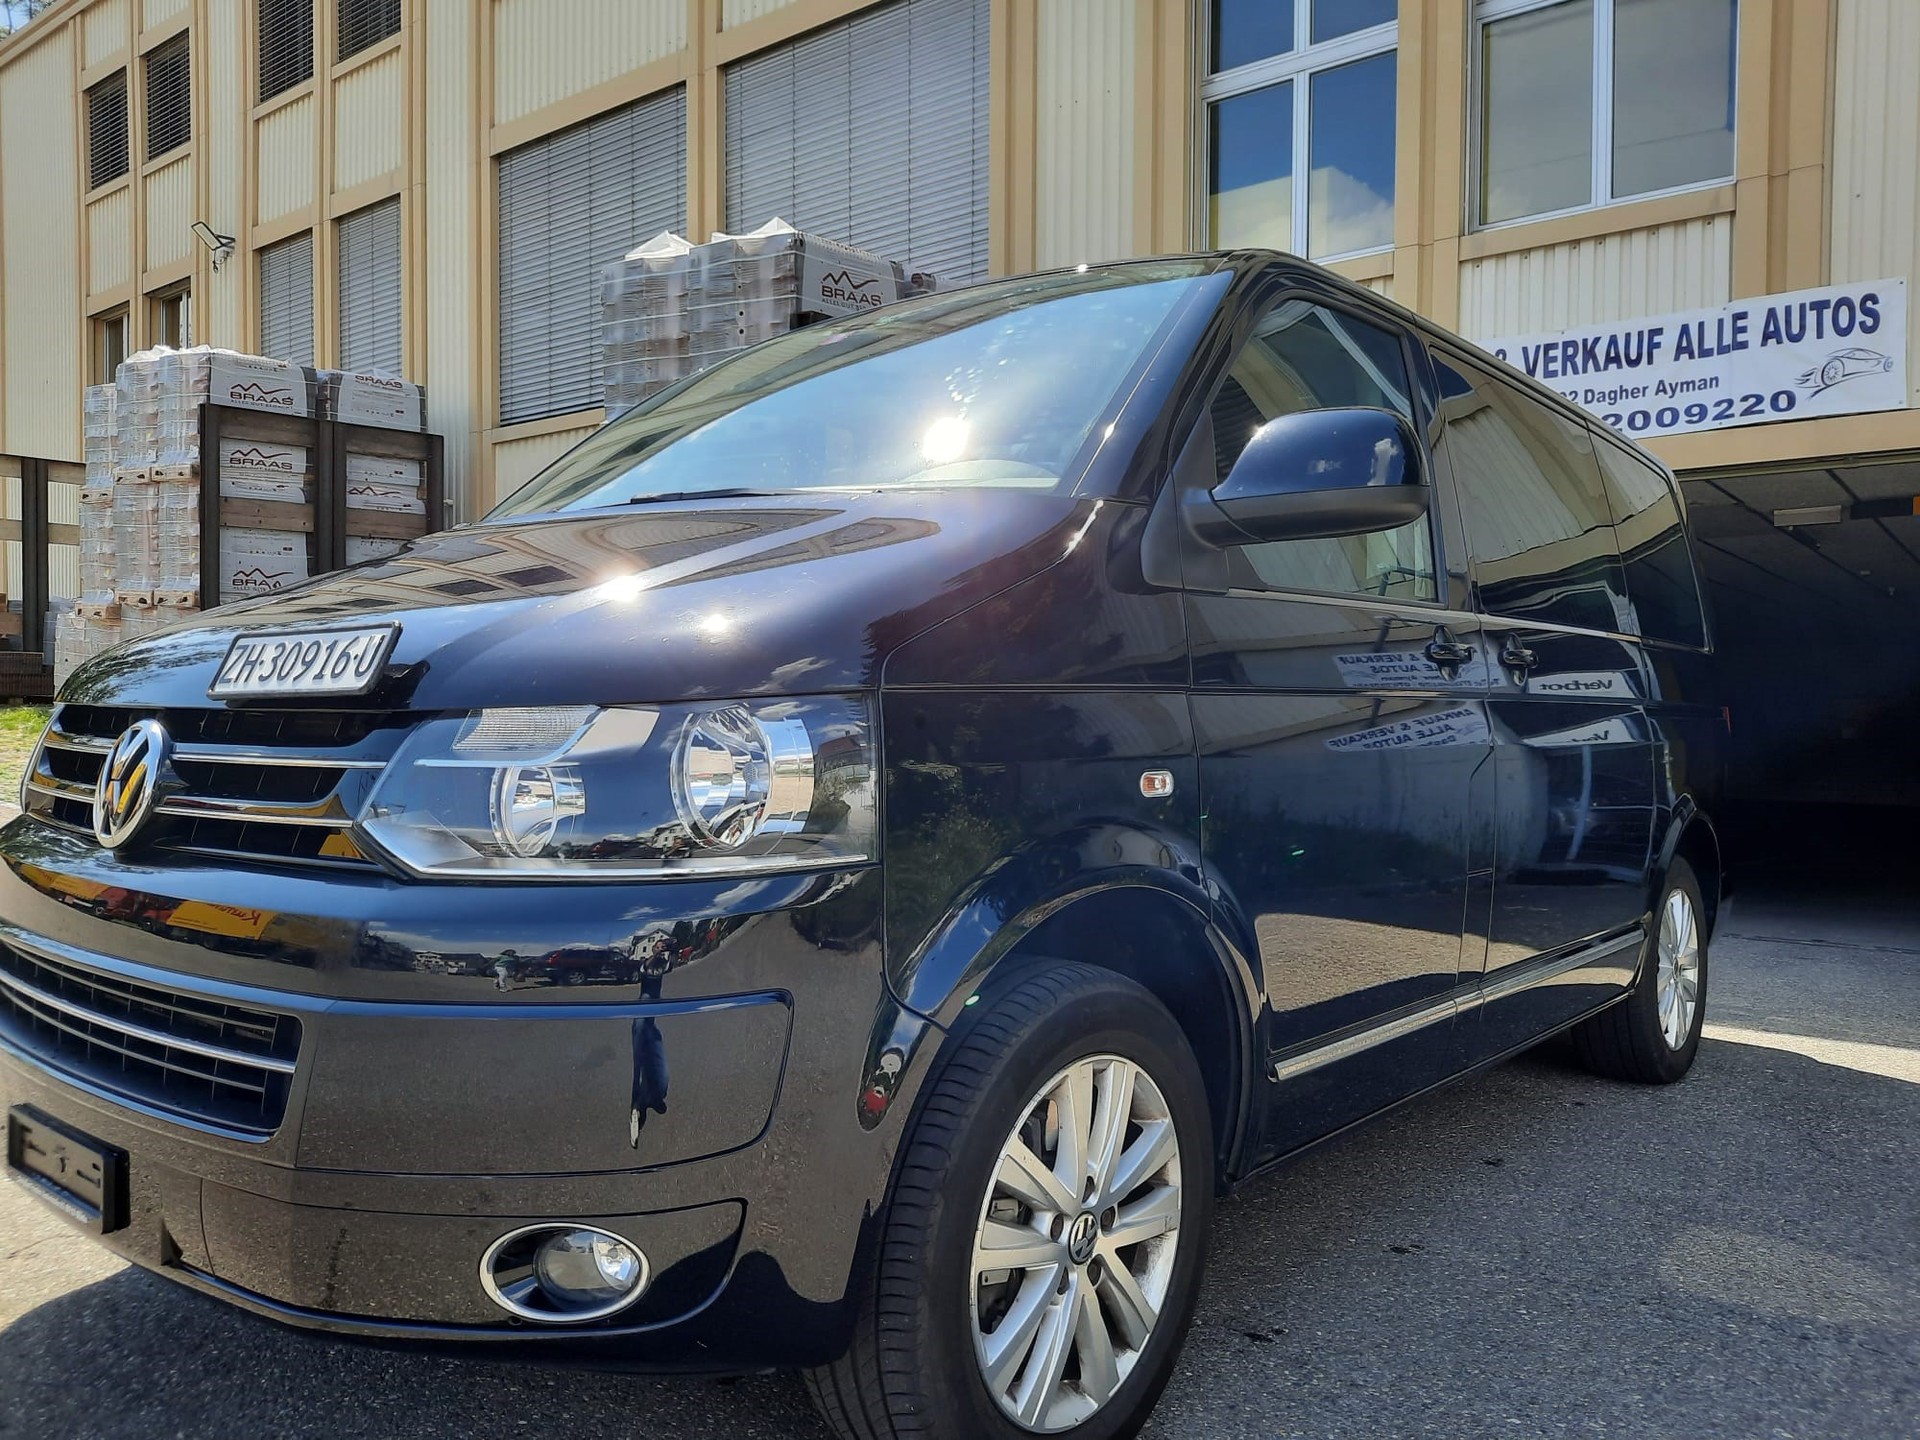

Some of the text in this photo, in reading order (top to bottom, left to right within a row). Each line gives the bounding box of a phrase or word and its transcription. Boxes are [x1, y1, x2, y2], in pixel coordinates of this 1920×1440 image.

[821, 284, 882, 307] BRAAS
[1521, 292, 1881, 379] VERKAUF ALLE AUTOS
[230, 391, 294, 406] BRAAS
[1583, 384, 1649, 406] Dagher
[1654, 375, 1720, 400] Ayman
[1600, 390, 1797, 433] 2009220
[229, 457, 293, 470] BRAAS
